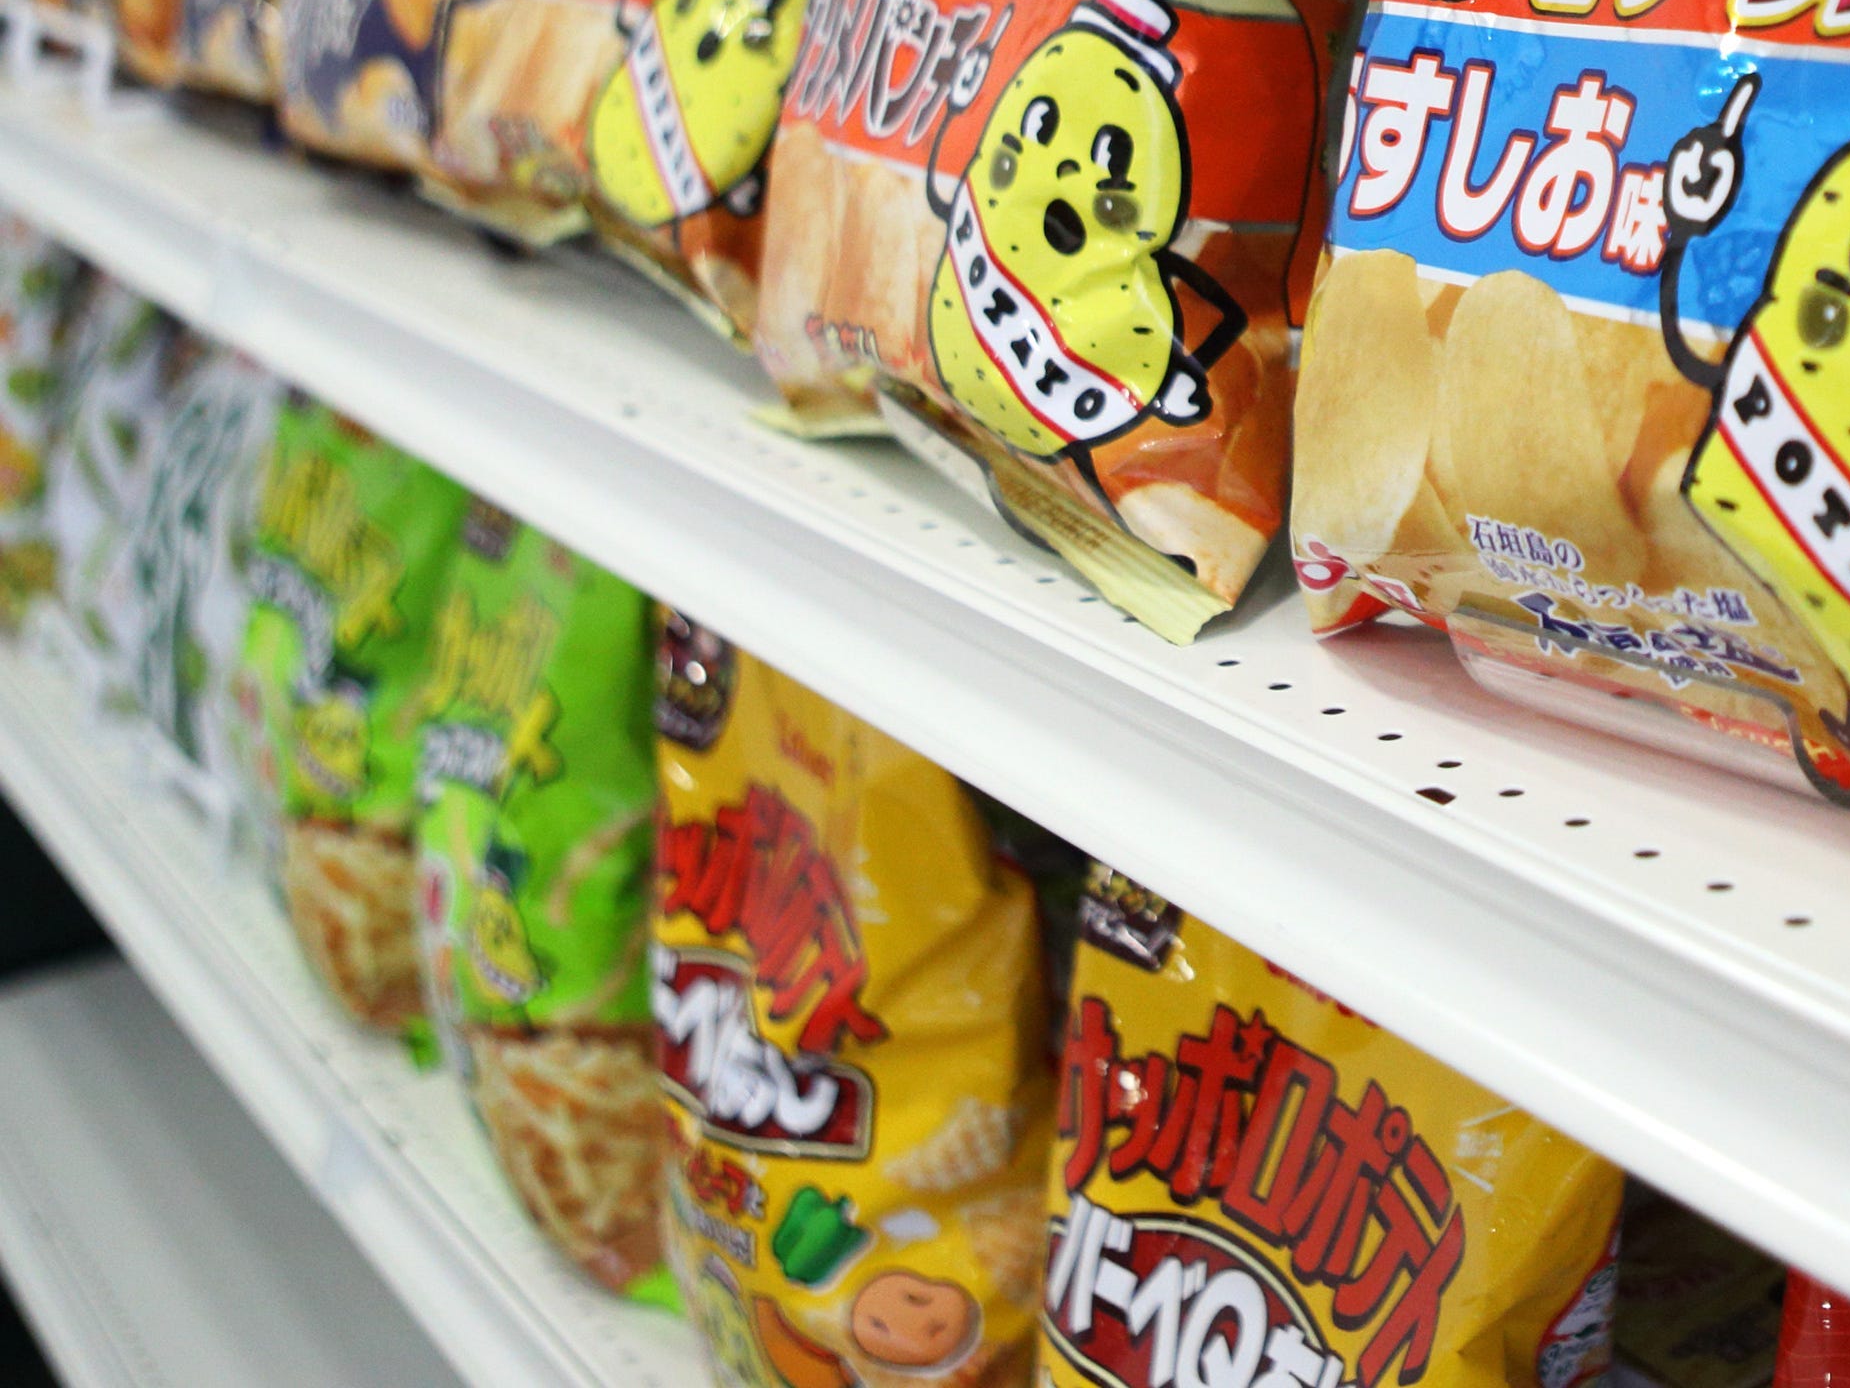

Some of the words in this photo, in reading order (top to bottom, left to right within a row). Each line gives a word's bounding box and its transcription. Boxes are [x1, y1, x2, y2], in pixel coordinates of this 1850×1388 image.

[1338, 42, 1670, 276] すしお味
[955, 209, 1107, 422] POTATO
[1466, 513, 1586, 572] 石垣島の
